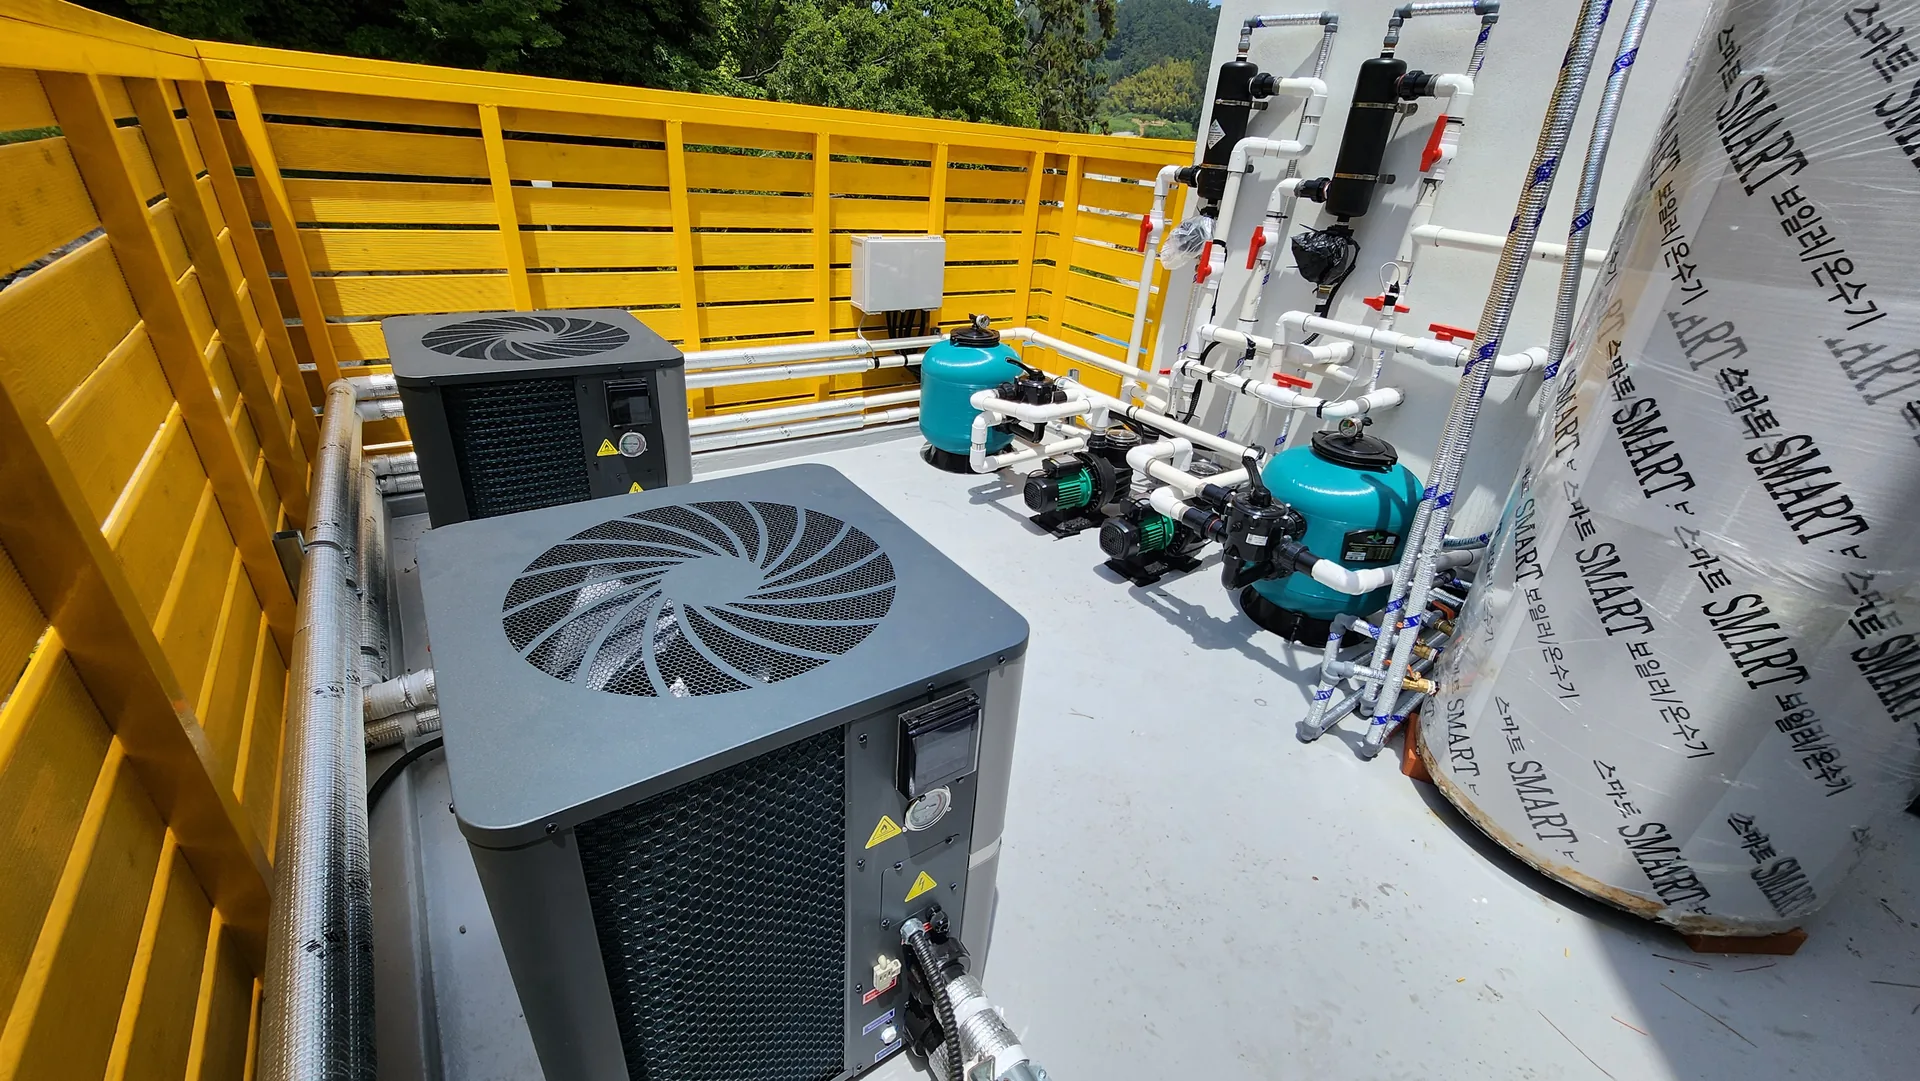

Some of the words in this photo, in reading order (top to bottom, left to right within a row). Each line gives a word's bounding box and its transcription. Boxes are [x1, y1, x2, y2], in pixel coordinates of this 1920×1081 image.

[1717, 24, 1743, 92] 스마트
[1844, 2, 1919, 84] 스마트
[1716, 74, 1809, 196] SMART
[1656, 180, 1709, 305] 보일러/온수기
[1770, 184, 1888, 331] 보일러/온수기
[1608, 340, 1636, 401] 스마트
[1720, 367, 1780, 438] 스마트
[1612, 397, 1696, 499] SMART
[1746, 434, 1870, 545] SMART
[1514, 498, 1544, 582] SMART
[1563, 480, 1596, 541] 스마트
[1575, 542, 1655, 636] SMART
[1674, 525, 1732, 594] 스마트
[1524, 587, 1580, 699] 보일러/온수기
[1701, 593, 1811, 690] SMART
[1446, 698, 1480, 776] SMART
[1494, 696, 1525, 754] 스마트
[1626, 641, 1715, 759] 보일러/온수기
[1507, 760, 1579, 842] SMART
[1616, 822, 1711, 906] SMART
